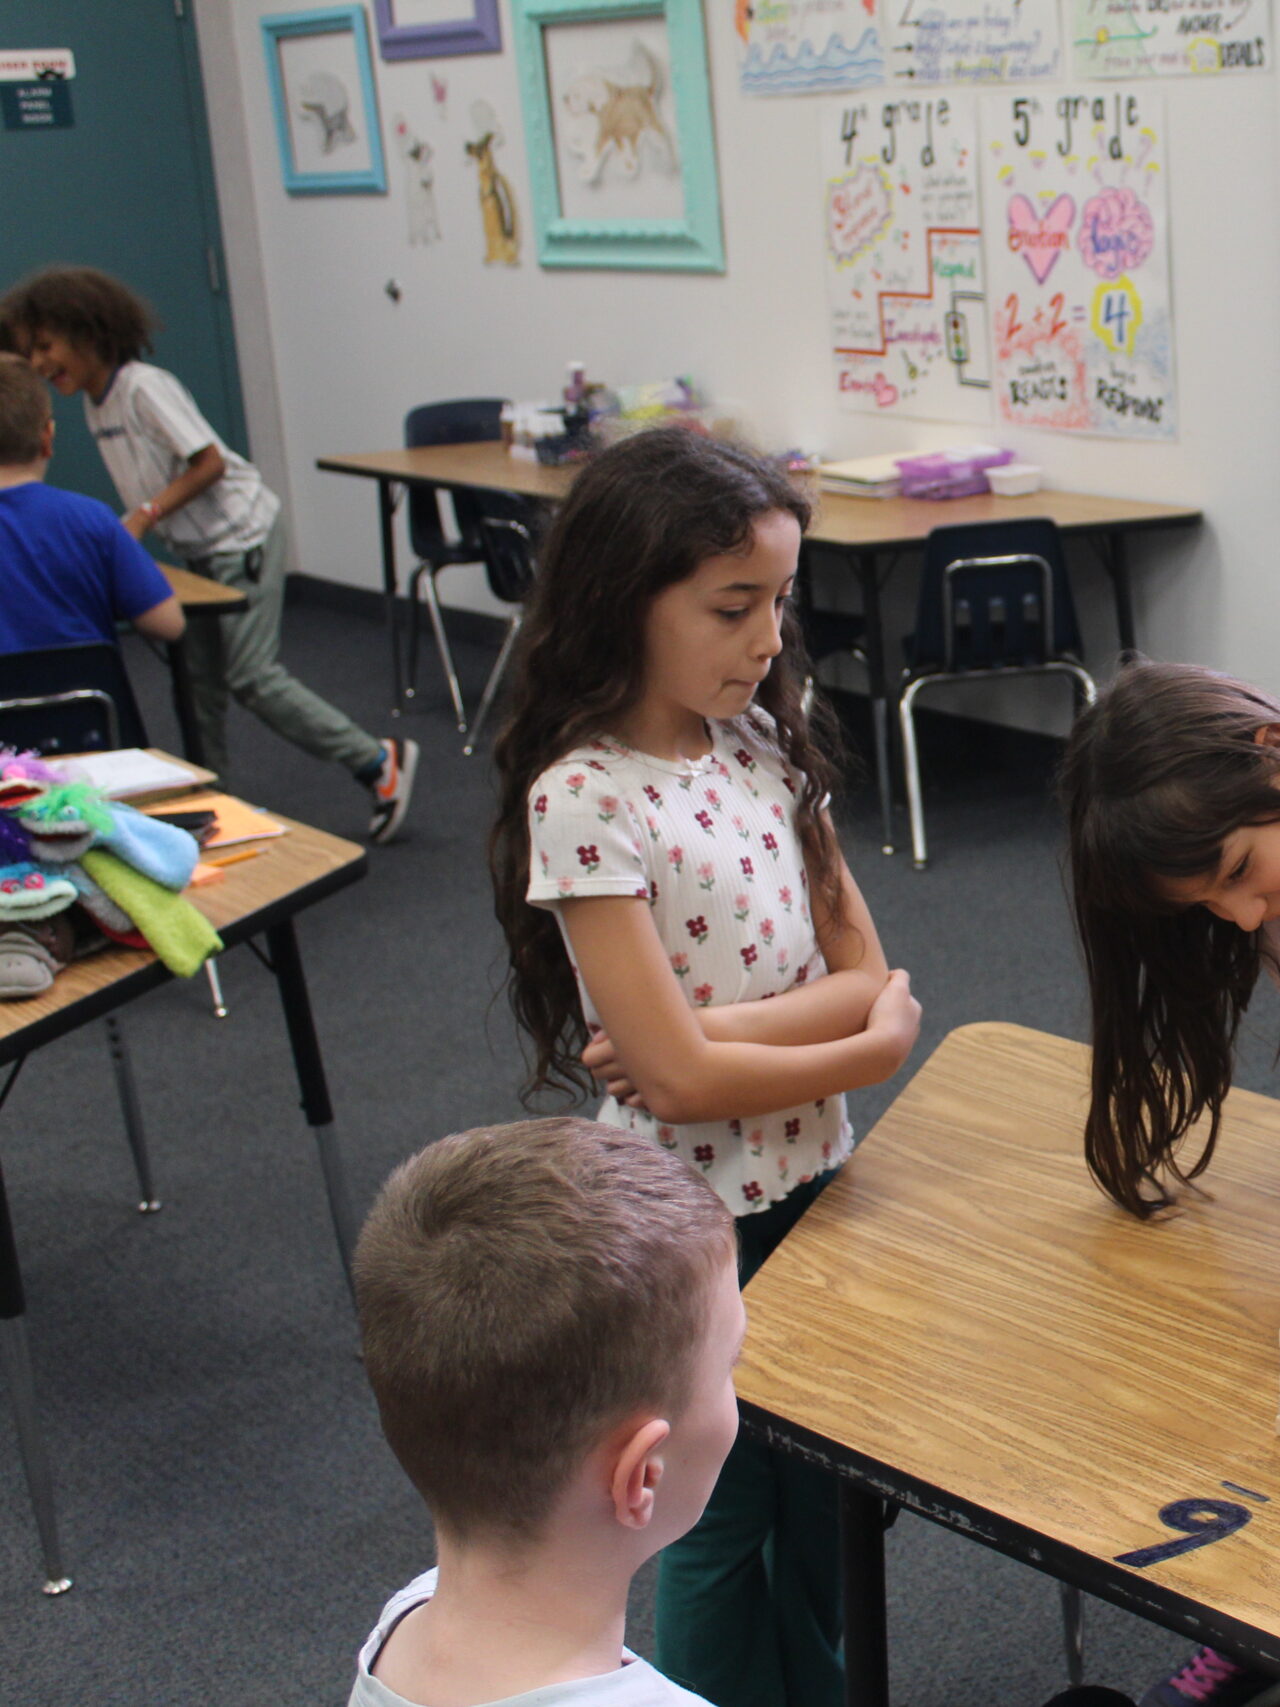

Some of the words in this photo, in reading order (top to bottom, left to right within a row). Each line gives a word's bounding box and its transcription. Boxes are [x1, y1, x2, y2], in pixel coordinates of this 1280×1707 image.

[1056, 92, 1140, 161] grade
[1006, 292, 1023, 341] 2
[1050, 292, 1068, 335] 2
[1105, 293, 1130, 344] 4
